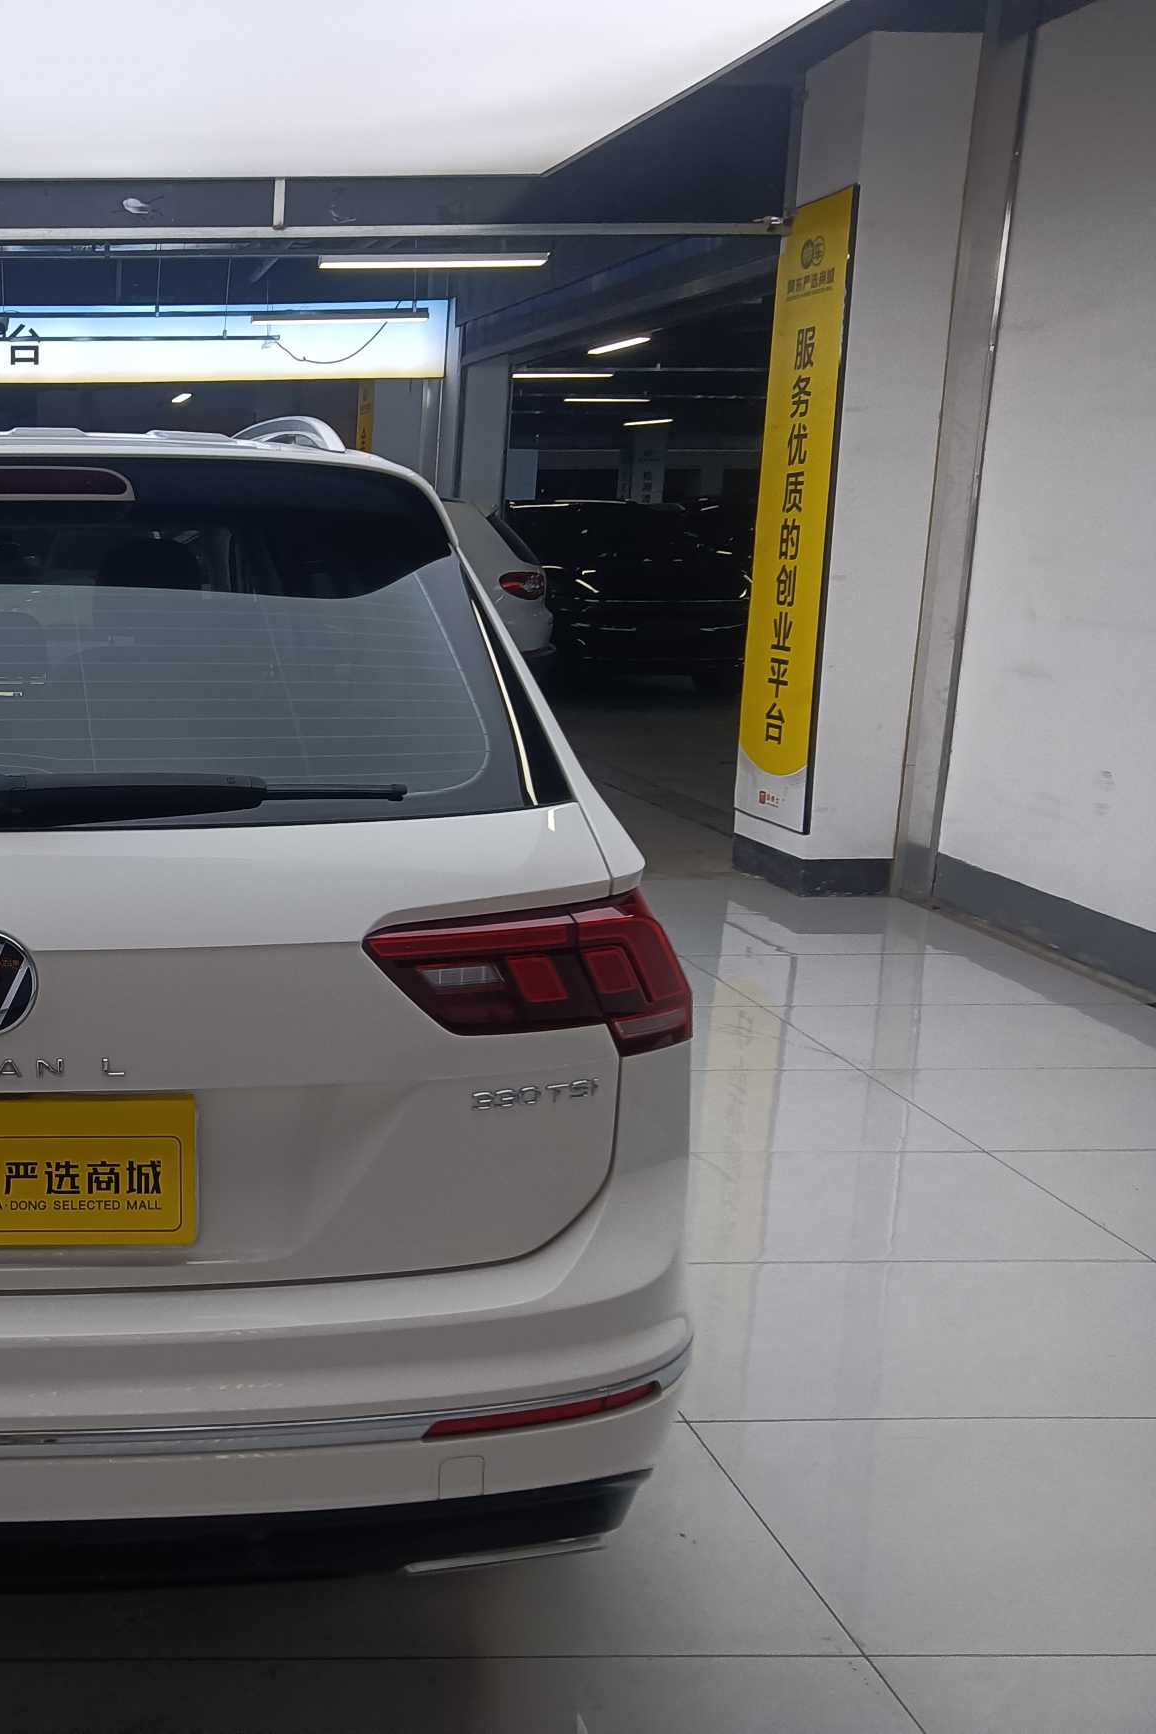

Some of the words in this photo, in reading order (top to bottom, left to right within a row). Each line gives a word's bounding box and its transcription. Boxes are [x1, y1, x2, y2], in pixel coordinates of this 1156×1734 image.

[764, 325, 816, 745] 服务优质的创业平台
[101, 1057, 125, 1077] L
[53, 1200, 121, 1211] SELECTED
[126, 1200, 162, 1211] MALL
